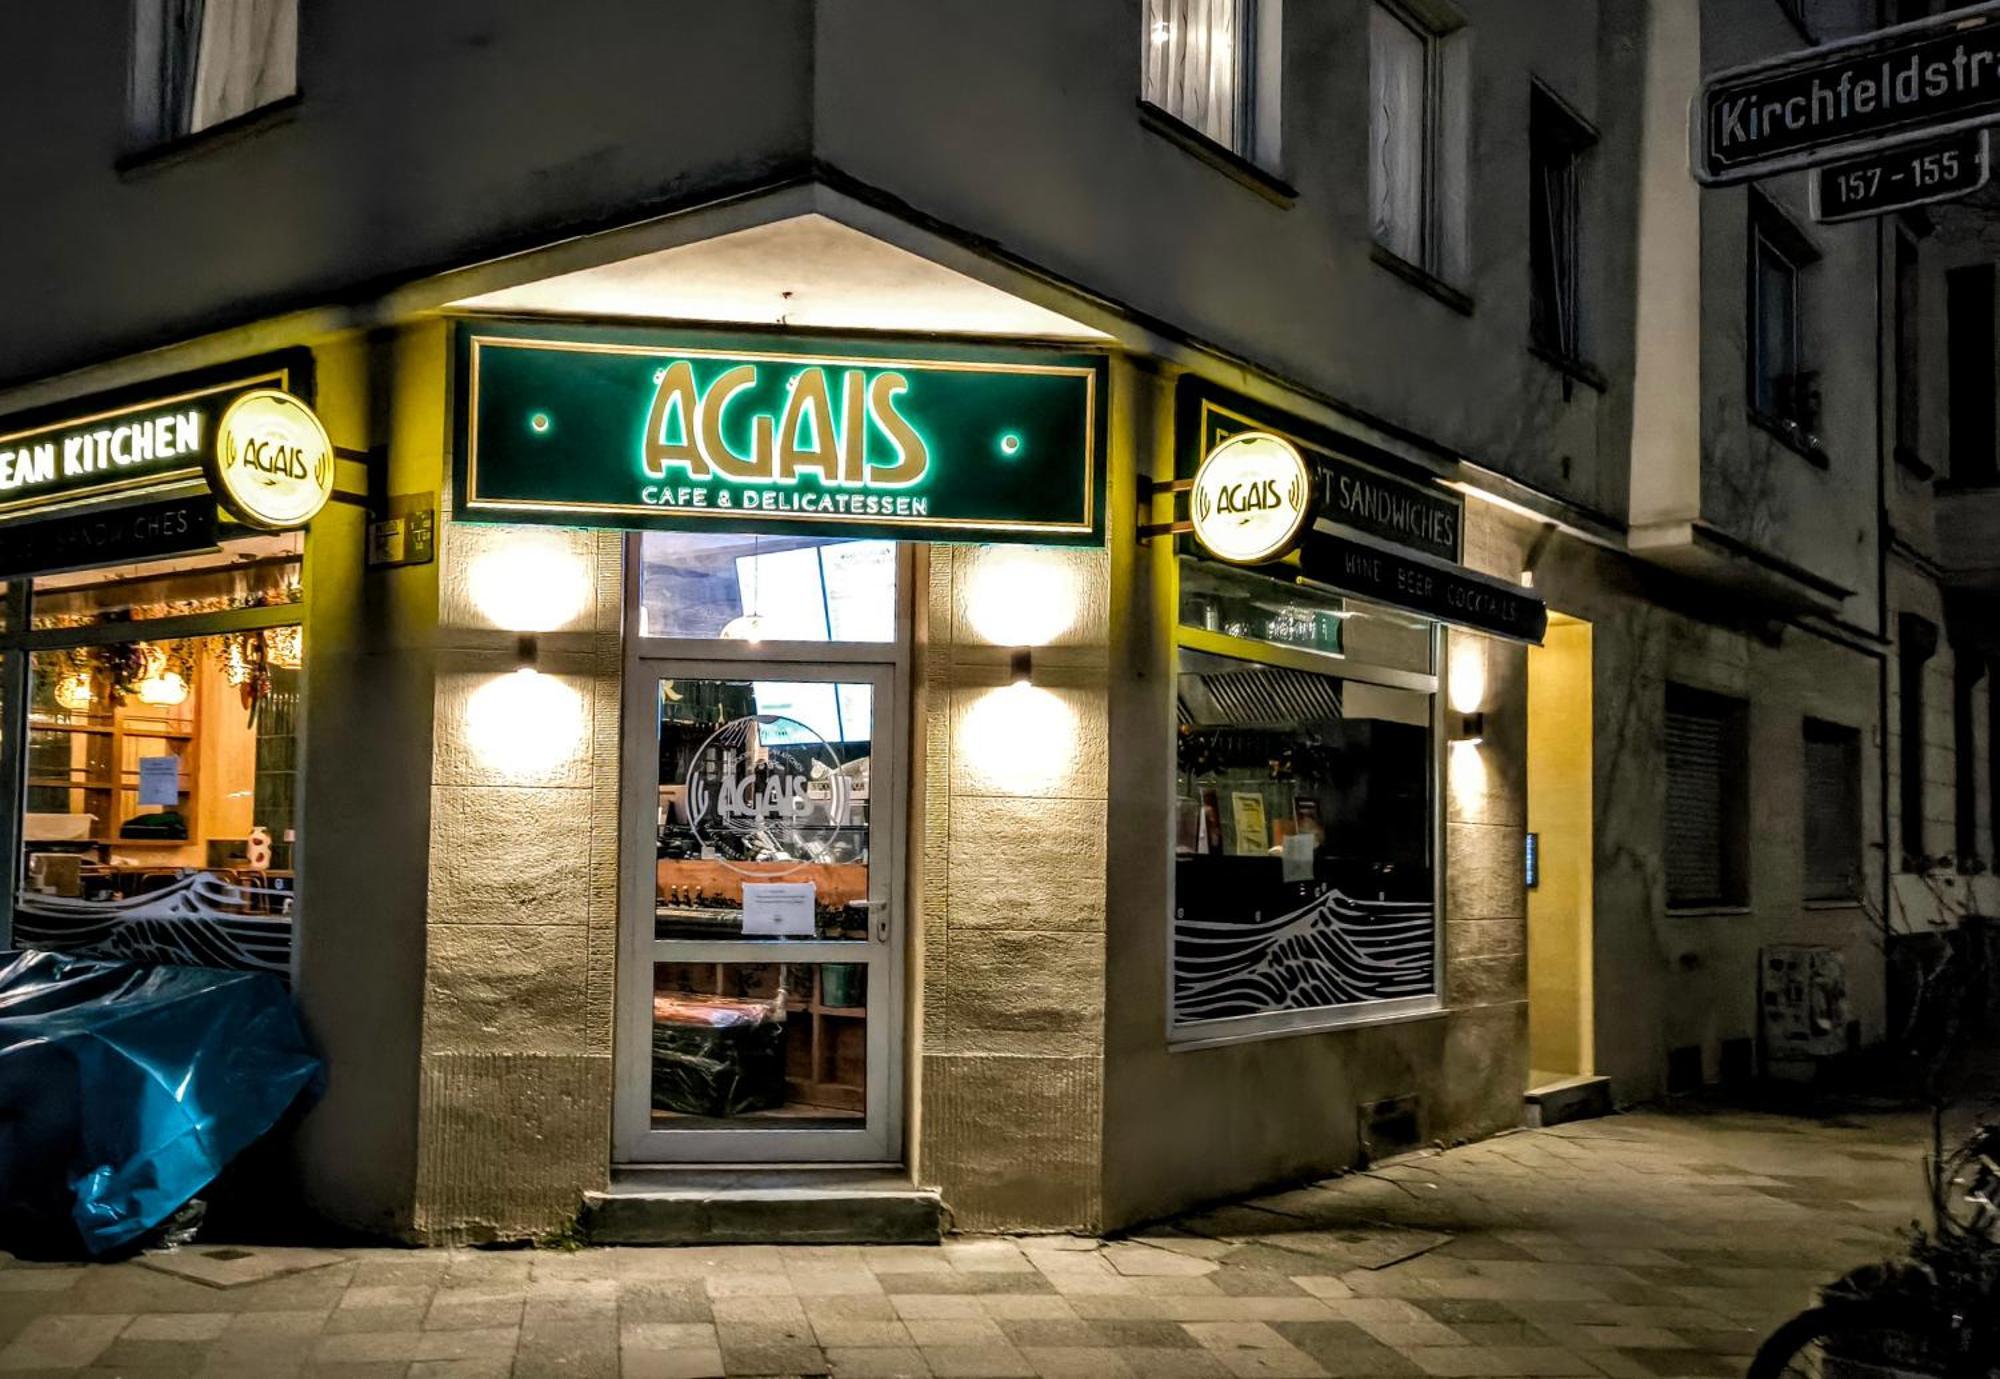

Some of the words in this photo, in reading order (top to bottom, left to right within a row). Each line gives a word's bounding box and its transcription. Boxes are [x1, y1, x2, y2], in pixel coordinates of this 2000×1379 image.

[1721, 45, 2000, 147] Kirchfeldstr
[1837, 168, 1882, 202] 157
[1911, 151, 1959, 187] 155
[63, 411, 199, 477] KITCHEN
[643, 360, 929, 487] AGAIS
[243, 437, 308, 480] AGAIS
[642, 486, 707, 506] CAFE
[717, 490, 732, 508] &
[743, 489, 928, 516] DELICATESSEN
[1216, 480, 1281, 514] AGAIS
[1339, 476, 1454, 547] SANDWICHES
[56, 509, 189, 552] NDCHES
[1345, 552, 1383, 583] WINE
[1396, 567, 1434, 599] BEER
[717, 774, 814, 817] AGAIS
